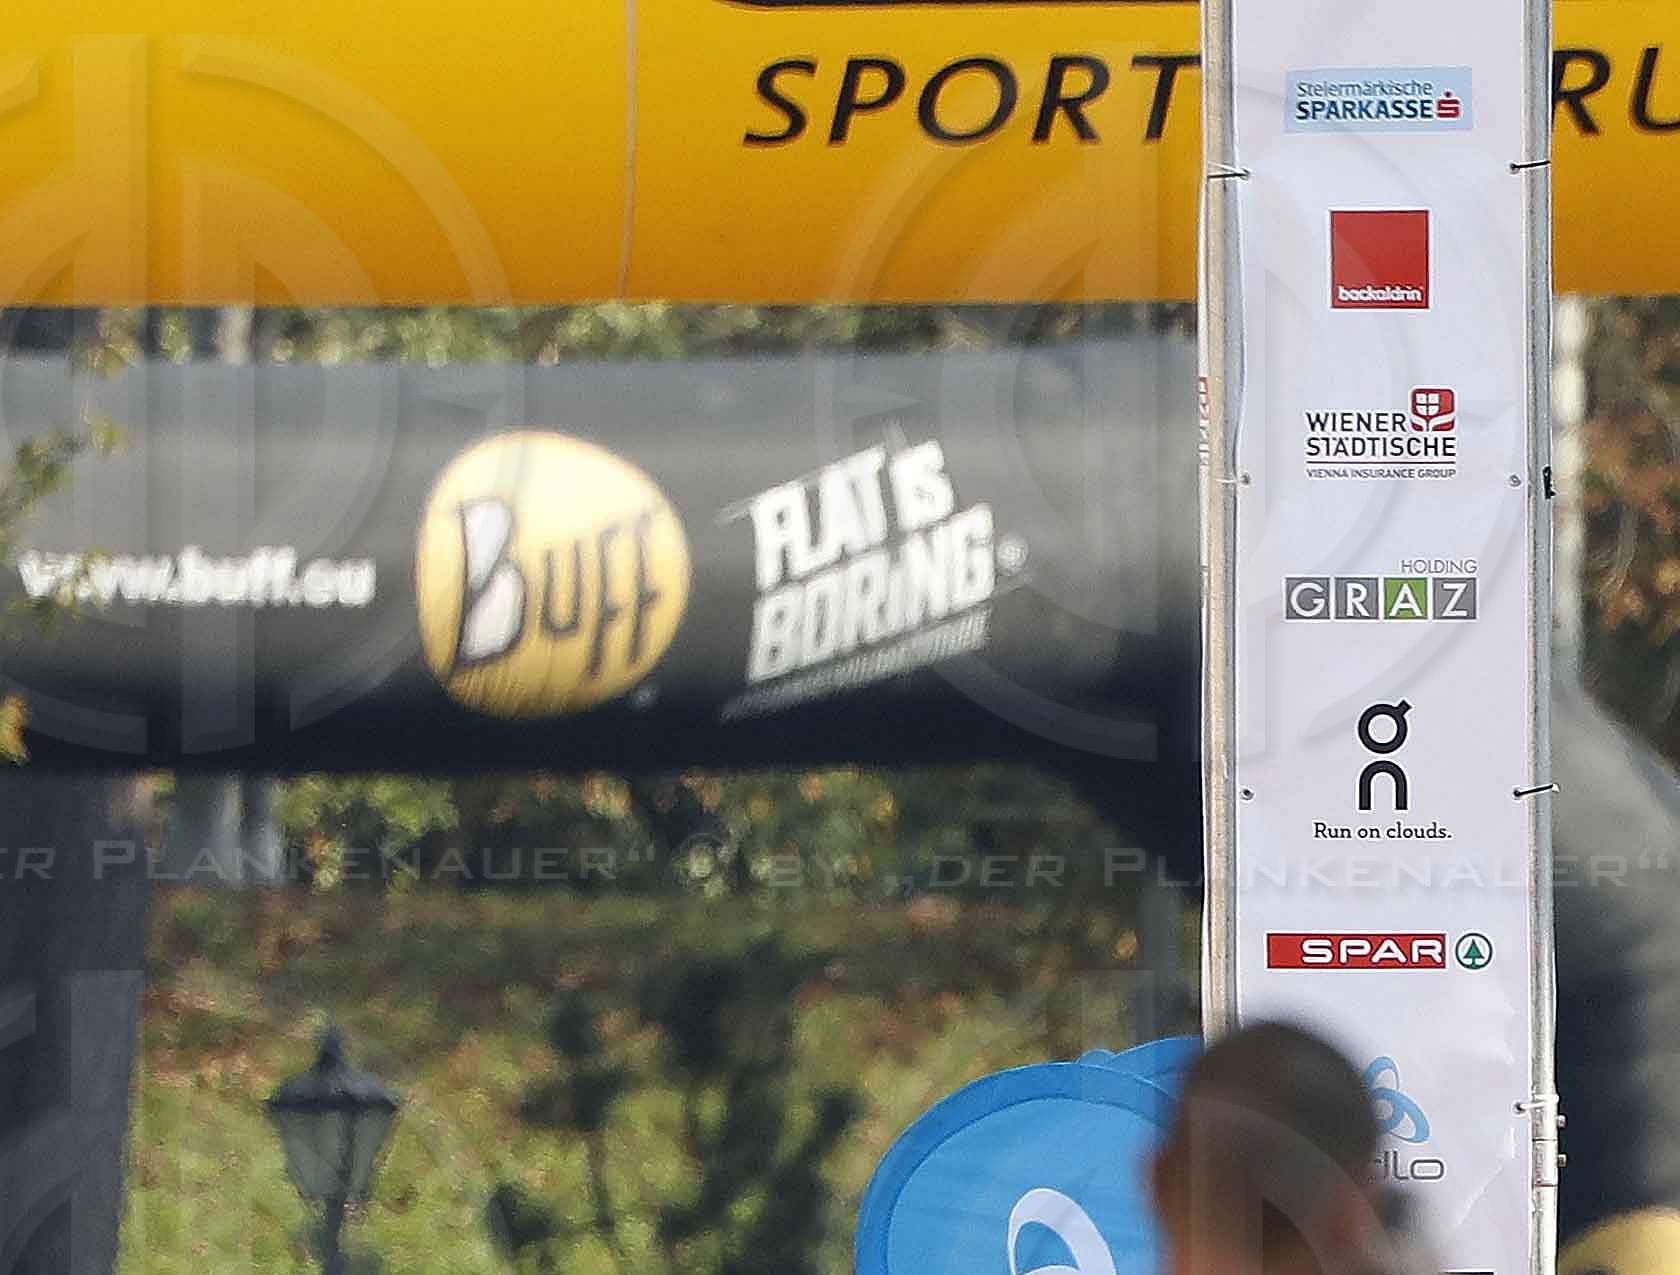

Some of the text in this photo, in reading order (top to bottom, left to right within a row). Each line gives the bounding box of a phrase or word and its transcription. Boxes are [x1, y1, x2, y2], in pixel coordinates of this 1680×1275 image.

[1296, 79, 1433, 97] Steiermärkische
[1295, 100, 1434, 121] SPARKASSE
[1305, 412, 1407, 433] WIENER
[1305, 434, 1457, 458] STÄDTISCHE
[1306, 468, 1457, 480] VIENNA INSURANCE GROUP
[1400, 558, 1478, 575] HOLDING
[1287, 580, 1472, 619] GRAZ
[1313, 821, 1452, 839] Run on clouds.
[1301, 939, 1443, 964] SPAR
